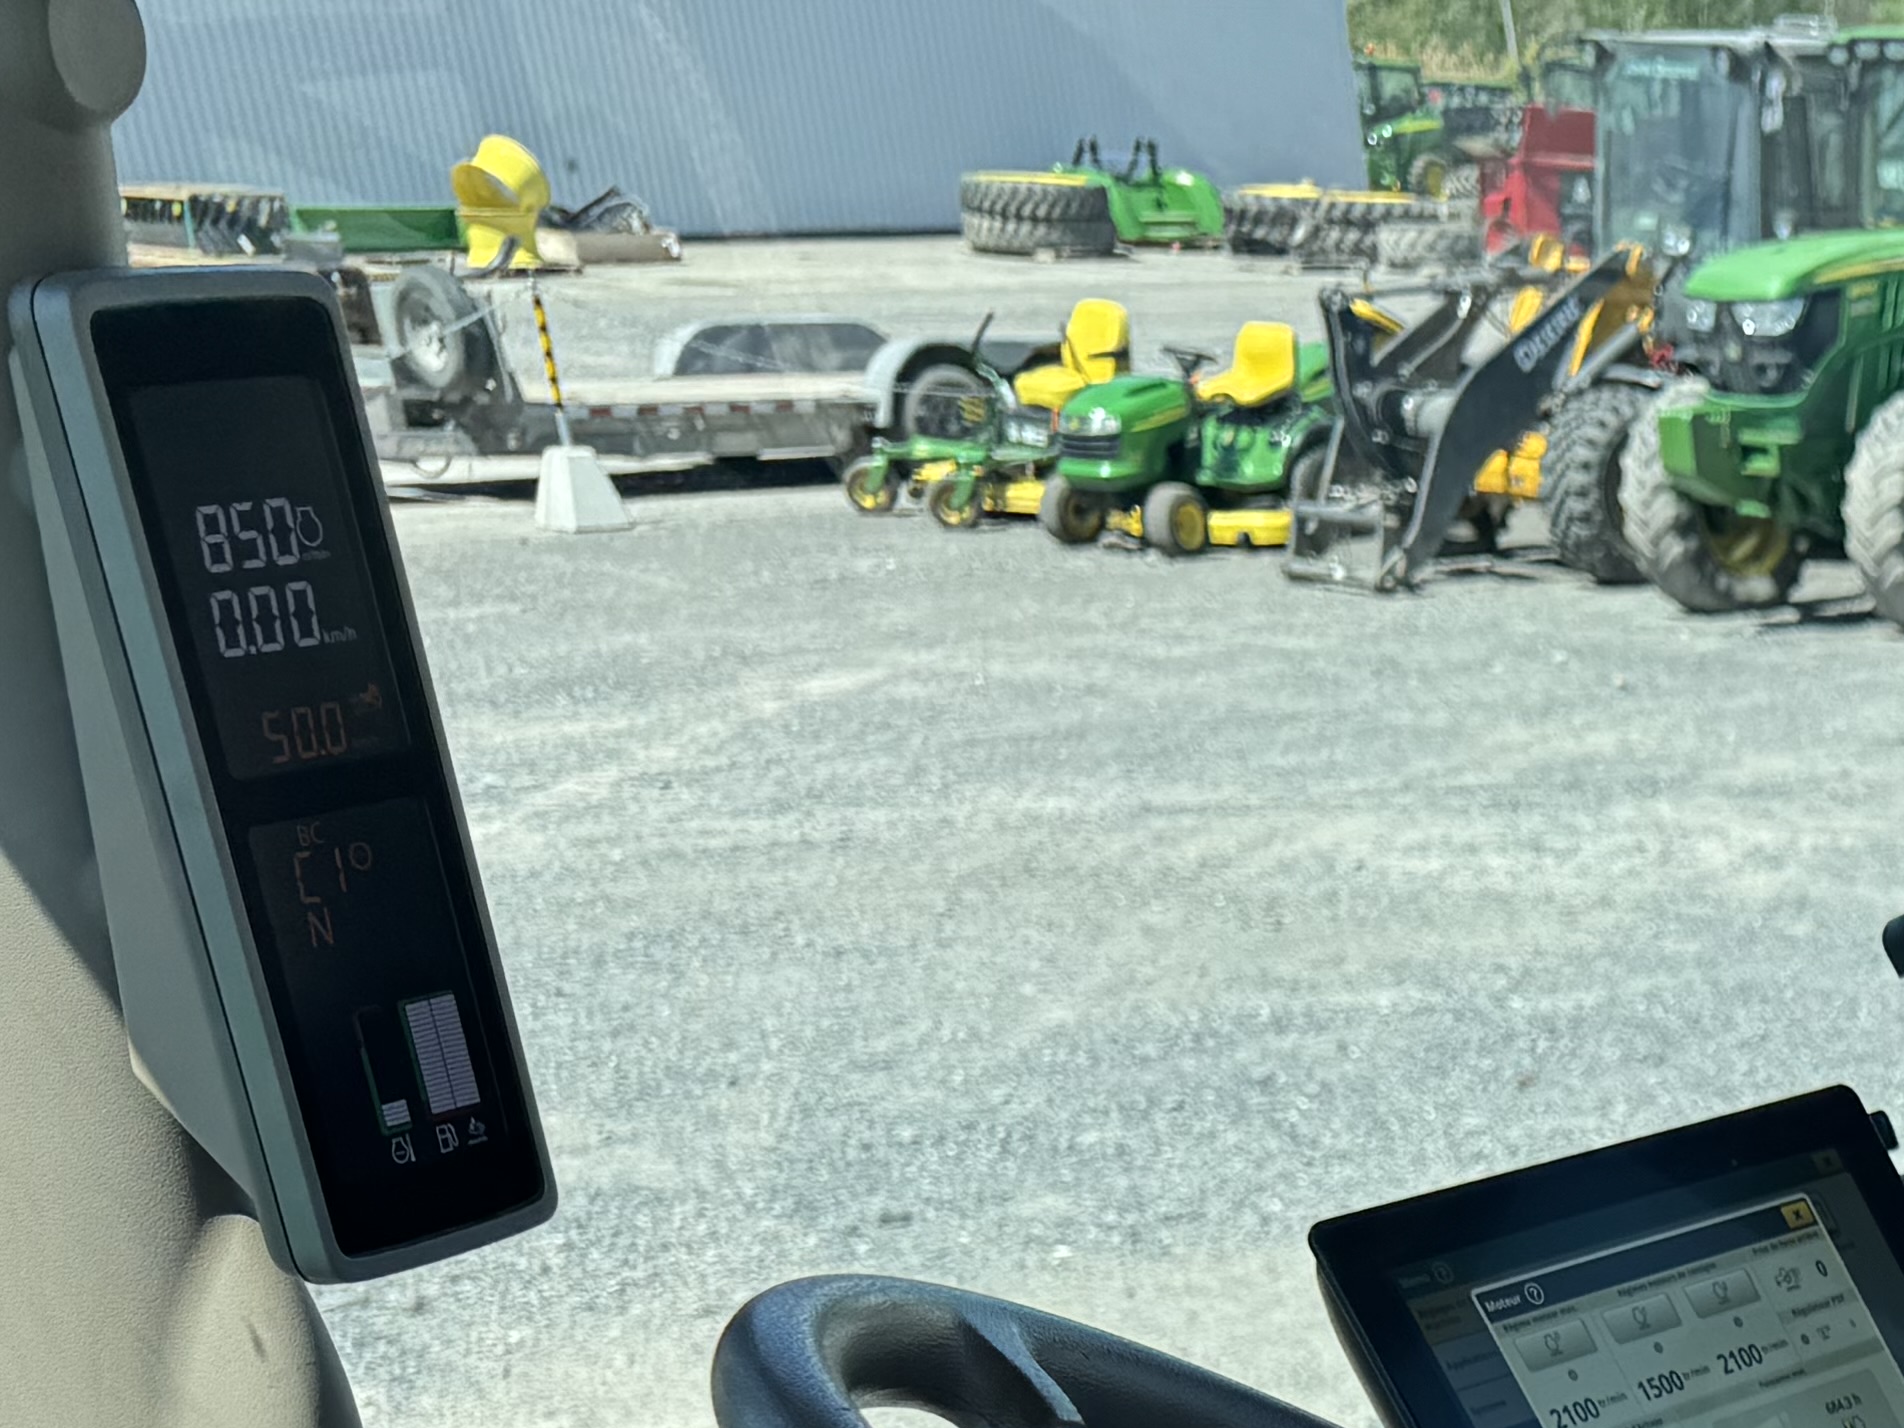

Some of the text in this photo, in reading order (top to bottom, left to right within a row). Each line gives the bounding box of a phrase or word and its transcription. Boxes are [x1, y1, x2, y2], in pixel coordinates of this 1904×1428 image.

[196, 497, 300, 574] 850
[210, 581, 358, 658] 0.00 km/h
[261, 702, 348, 764] 50.0
[307, 906, 336, 948] N
[1484, 1294, 1521, 1313] Moteur
[1717, 1343, 1764, 1375] 2100
[1637, 1369, 1686, 1401] 1500
